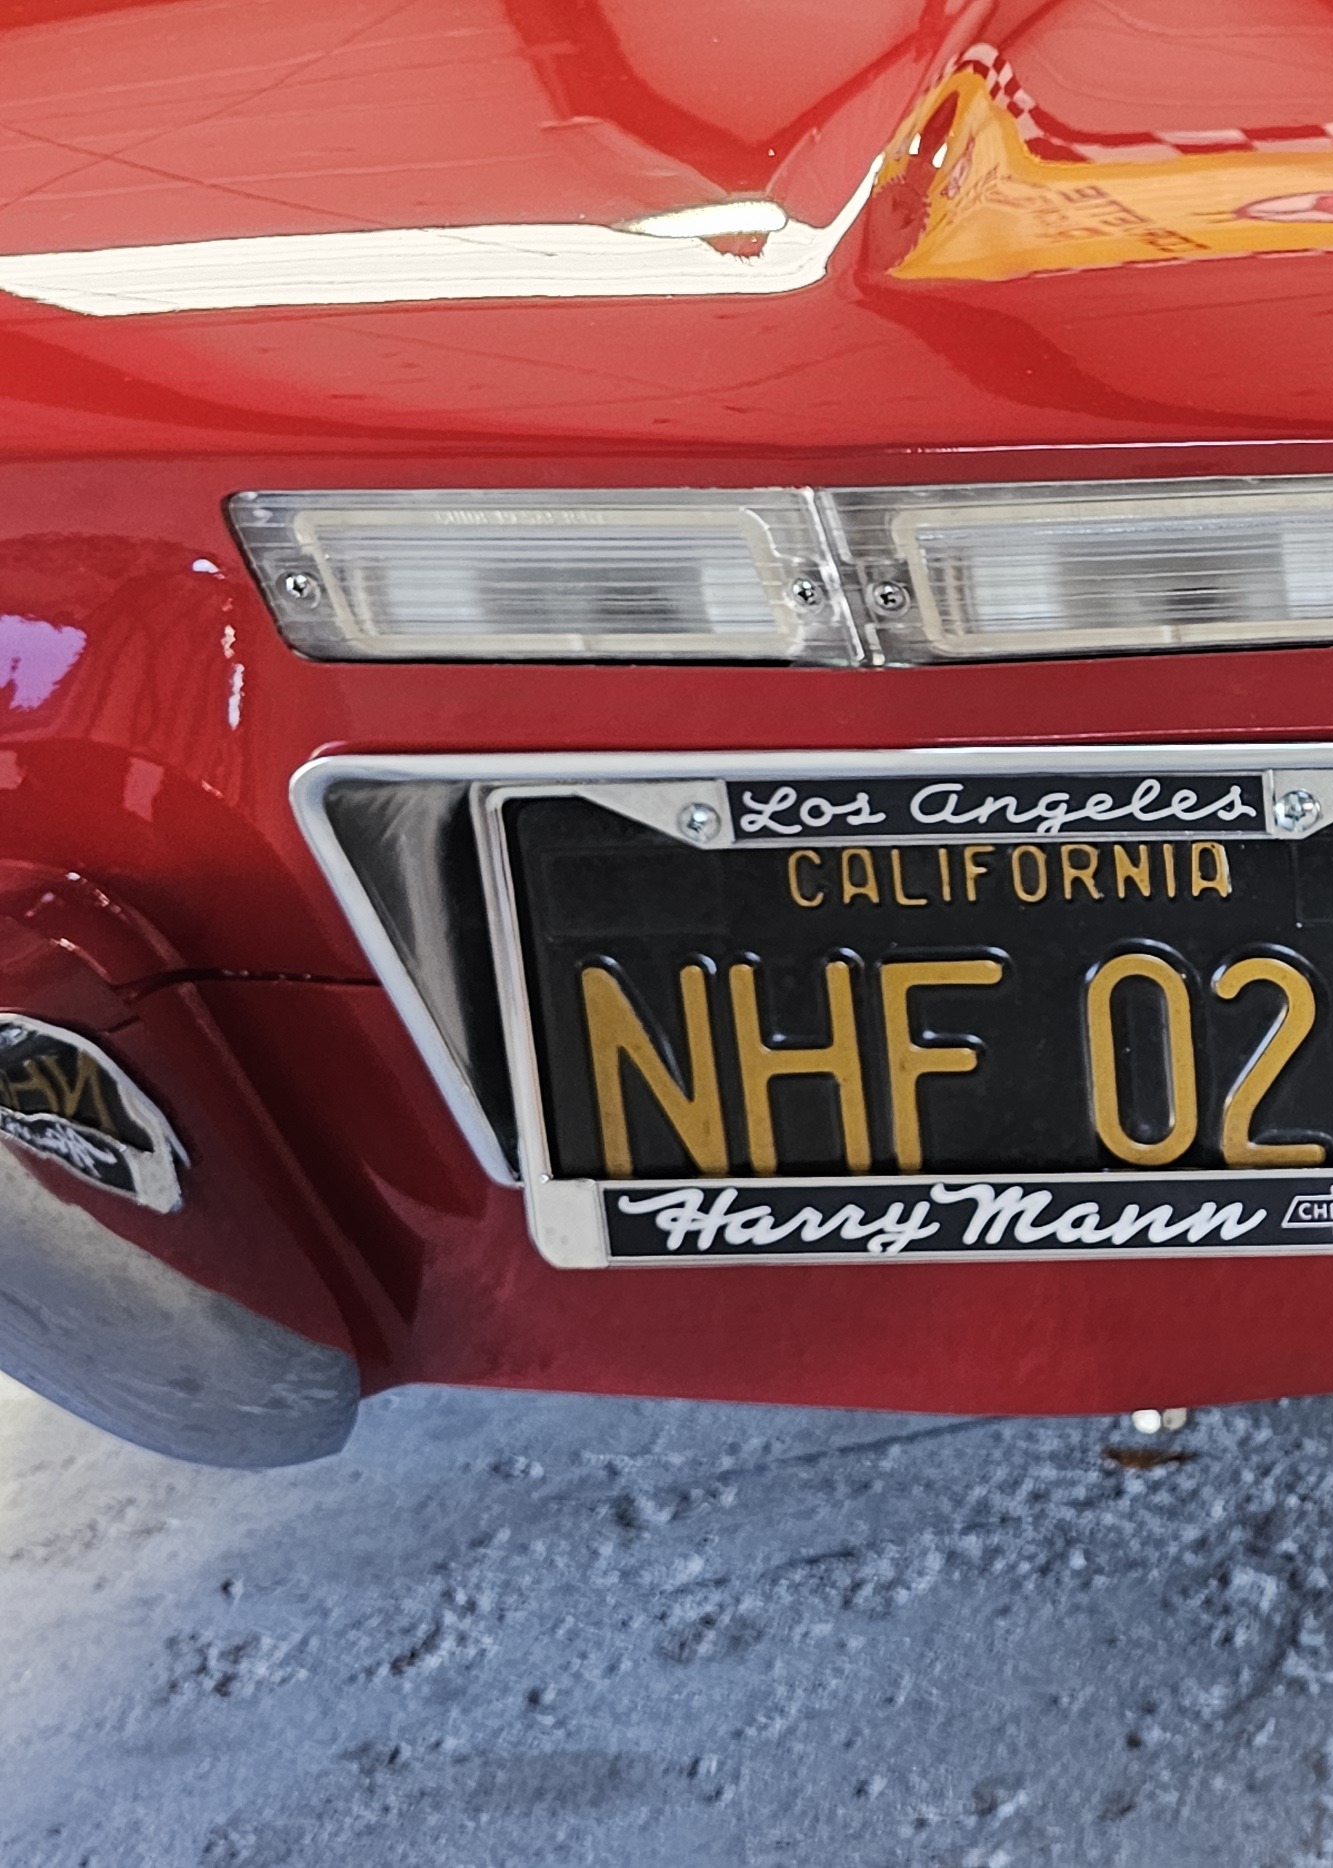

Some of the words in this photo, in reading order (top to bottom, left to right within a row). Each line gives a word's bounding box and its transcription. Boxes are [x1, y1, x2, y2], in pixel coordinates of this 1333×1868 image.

[739, 785, 887, 835] Los
[909, 778, 1258, 834] Angeles
[787, 842, 1232, 908] CALIFORNIA
[581, 958, 1004, 1175] NHF
[618, 1183, 940, 1254] Harry
[930, 1182, 1267, 1246] Mann
